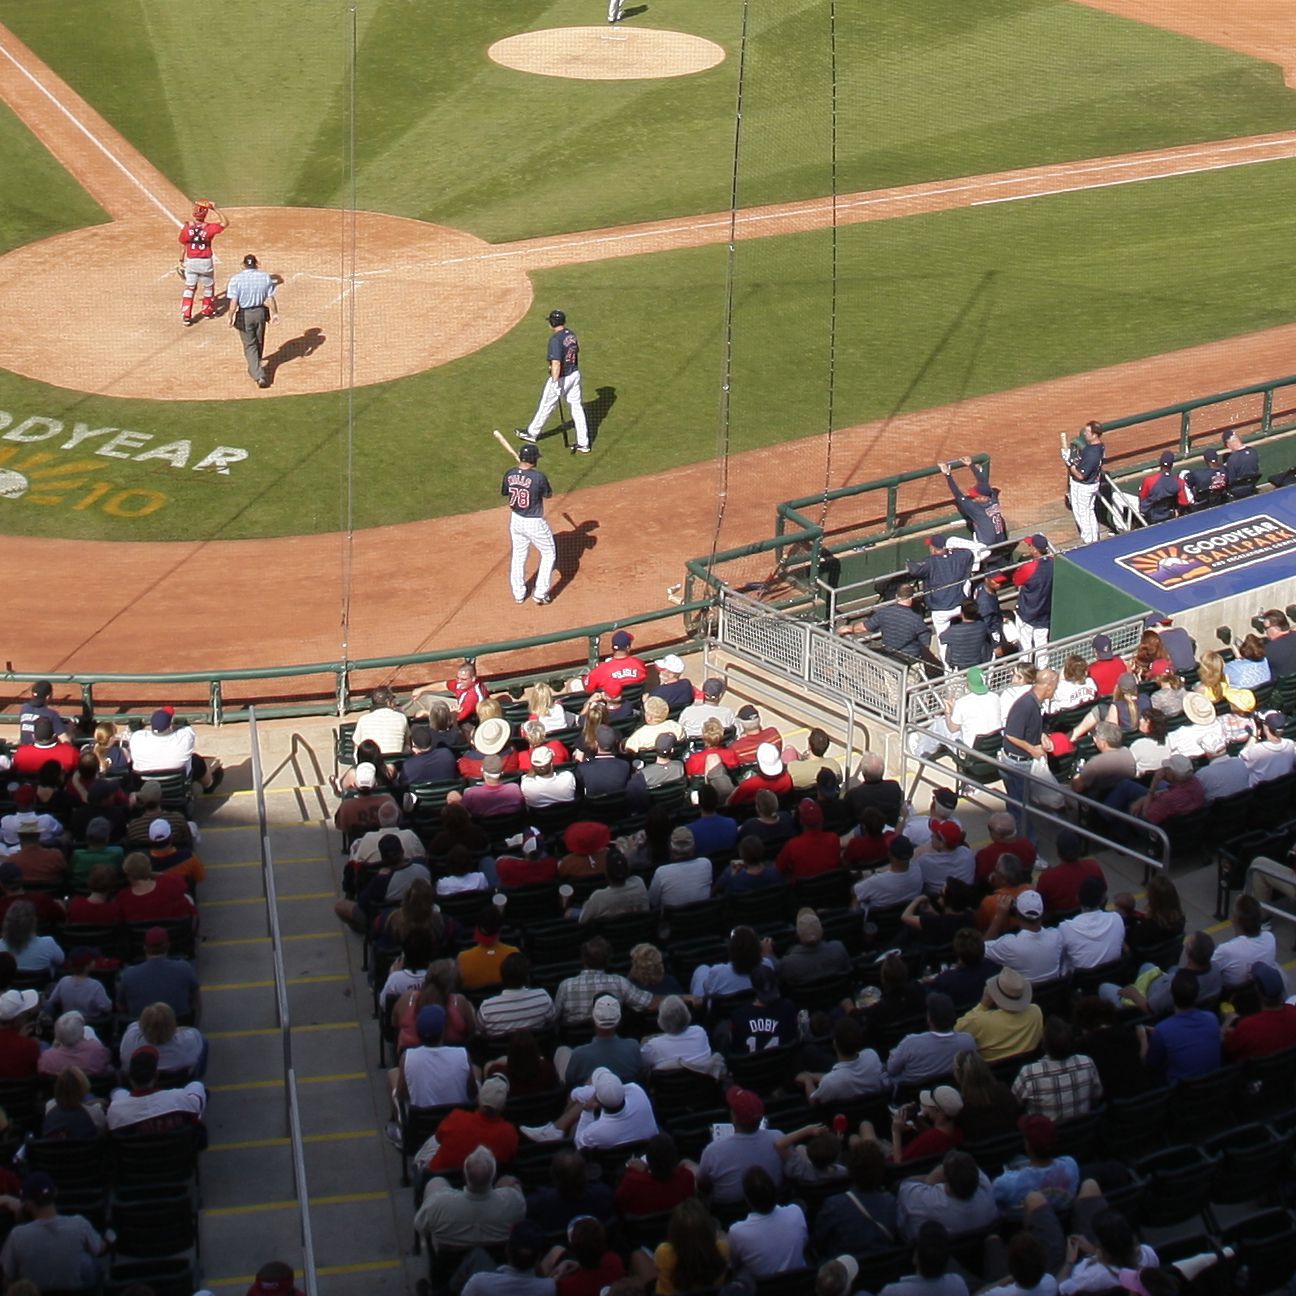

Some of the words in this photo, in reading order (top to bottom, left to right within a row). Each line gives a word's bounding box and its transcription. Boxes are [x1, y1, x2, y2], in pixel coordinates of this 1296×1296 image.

[71, 481, 170, 517] 10
[508, 486, 530, 508] 78
[1183, 520, 1279, 554] GOODYEAR
[1195, 528, 1296, 564] BALLPARK
[1212, 560, 1226, 568] AND
[1226, 546, 1271, 563] RECREATIONAL
[749, 1018, 779, 1033] DOBY
